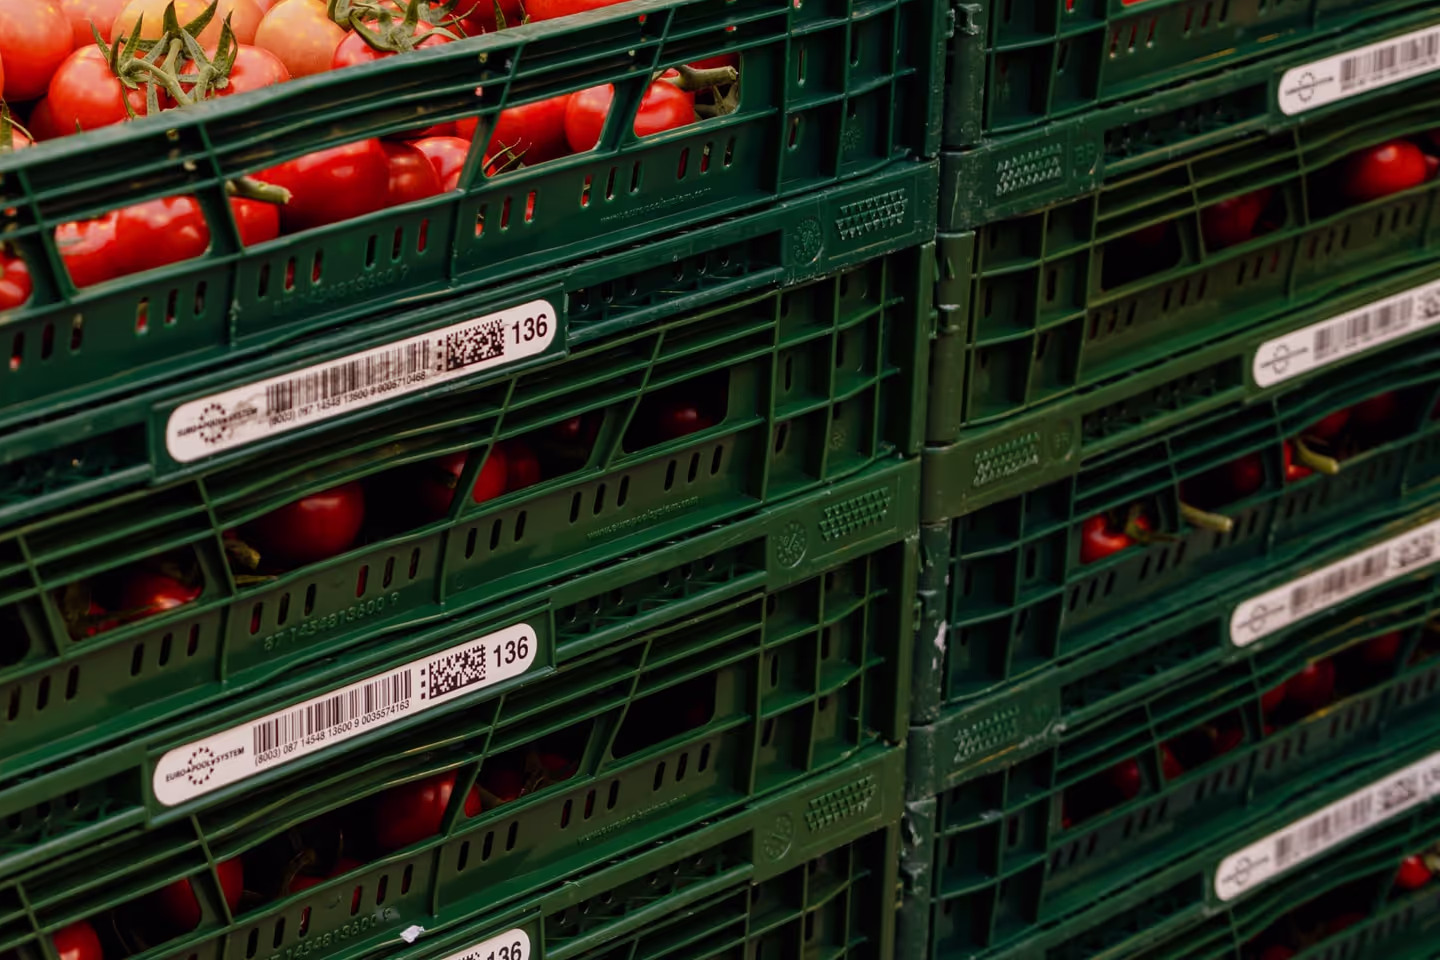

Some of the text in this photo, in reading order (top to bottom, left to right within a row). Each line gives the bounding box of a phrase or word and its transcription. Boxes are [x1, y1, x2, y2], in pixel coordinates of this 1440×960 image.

[512, 313, 548, 344] 136
[493, 636, 528, 667] 136
[255, 700, 410, 767] (8003) 087 14548 13600 9 0035574163
